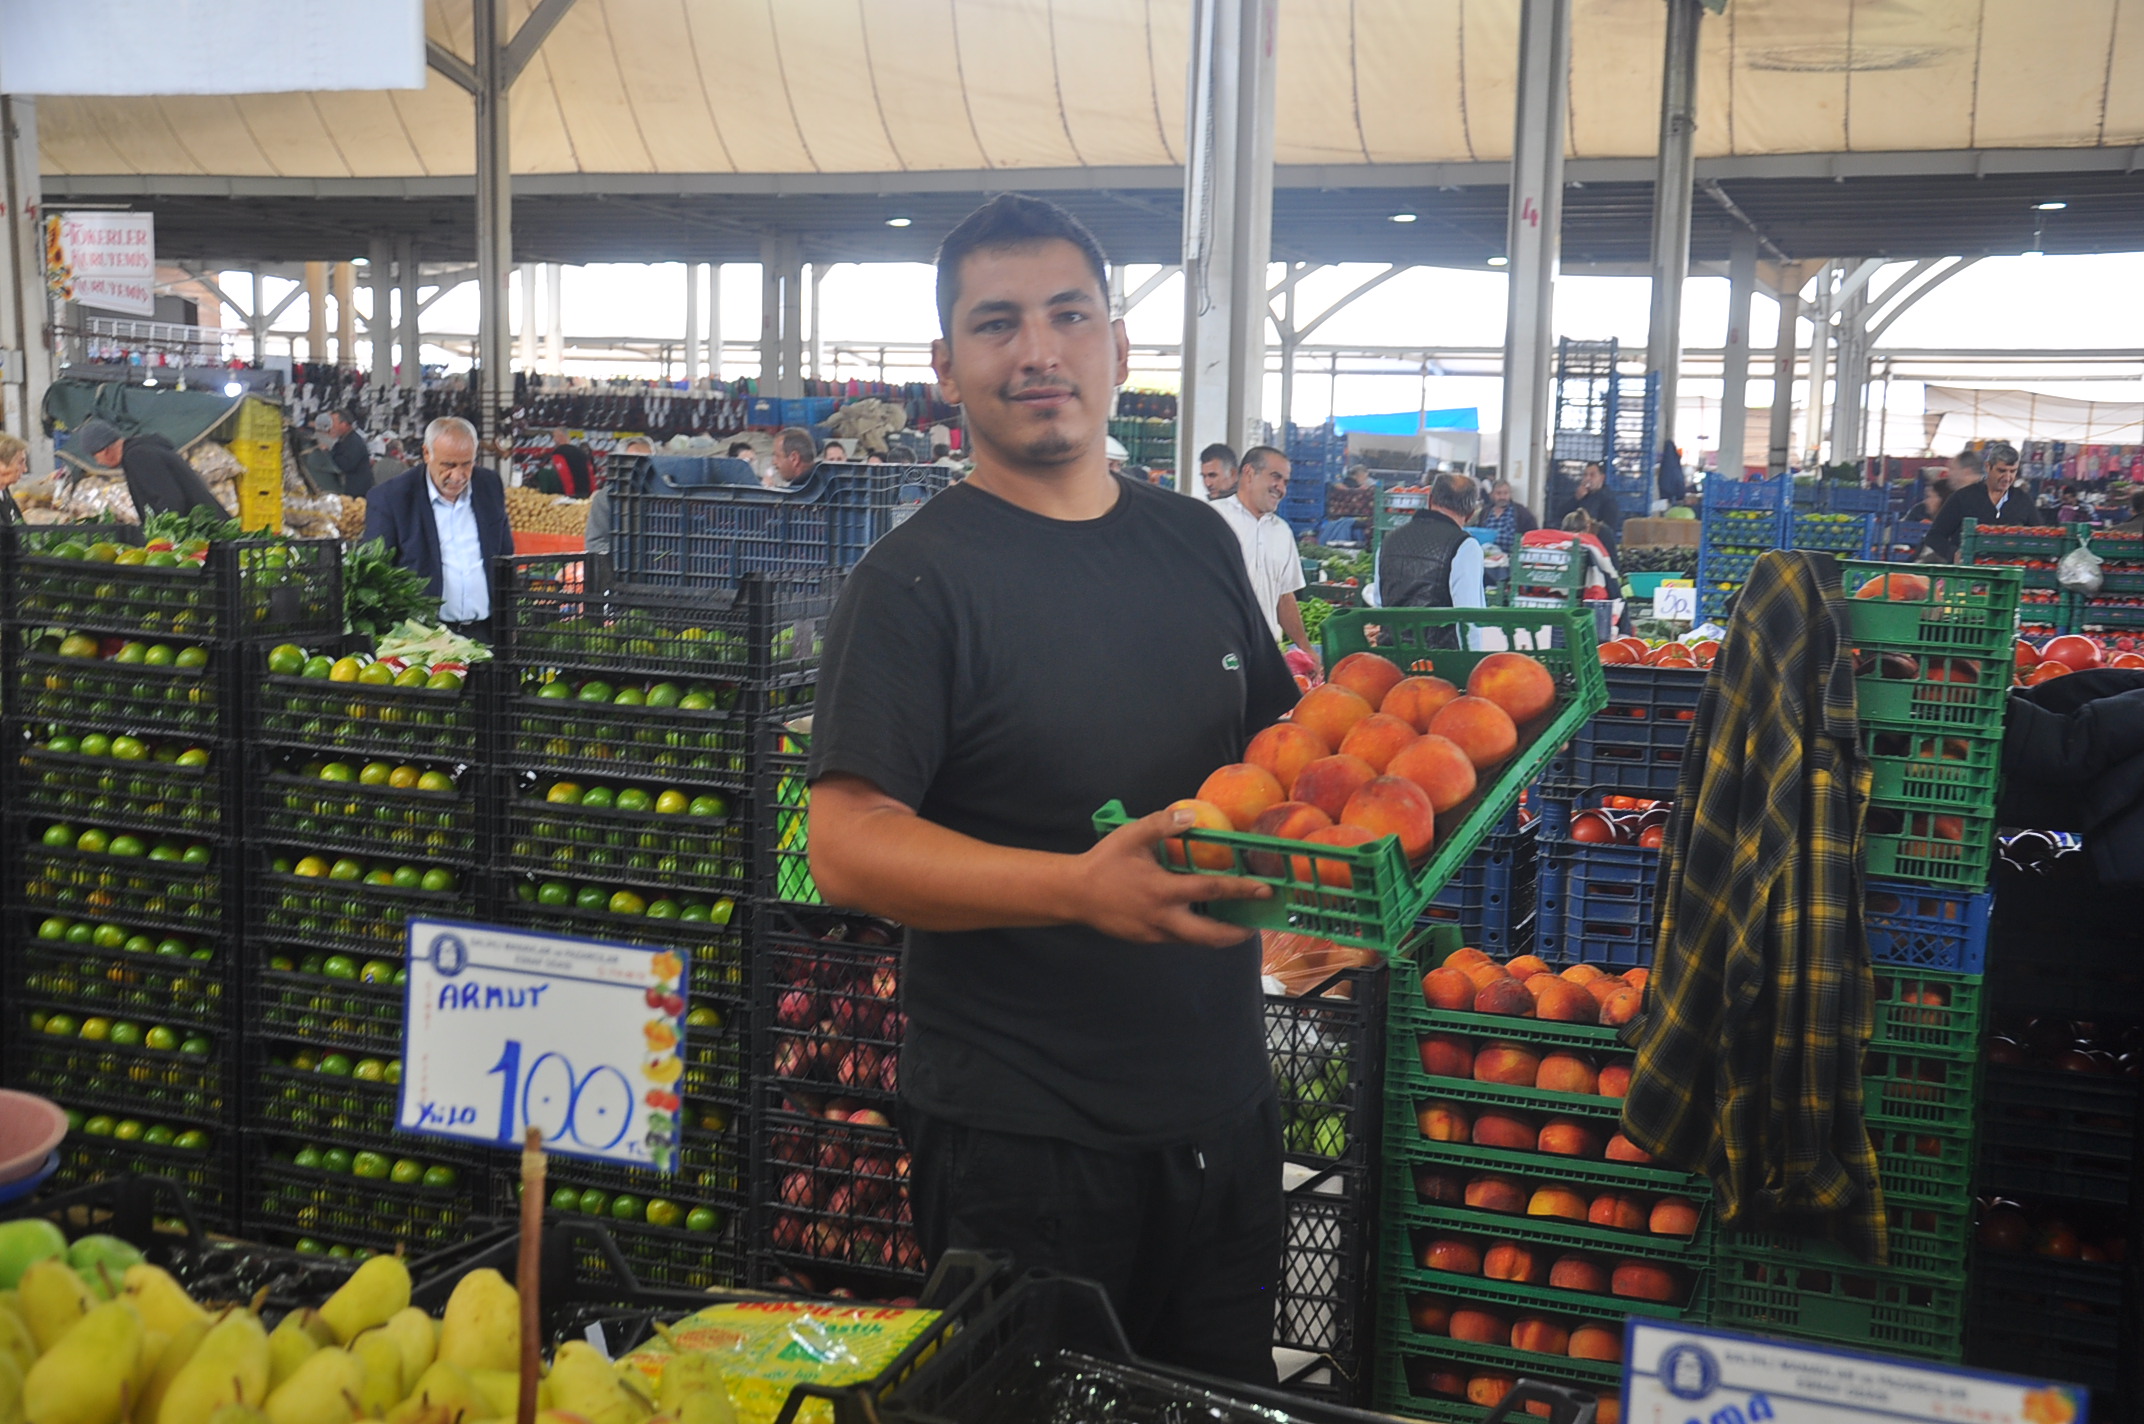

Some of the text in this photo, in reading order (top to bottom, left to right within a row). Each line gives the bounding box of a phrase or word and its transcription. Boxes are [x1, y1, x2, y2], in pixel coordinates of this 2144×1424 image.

[1522, 197, 1538, 227] 4
[438, 981, 549, 1010] ARMUT
[487, 1039, 634, 1150] 100
